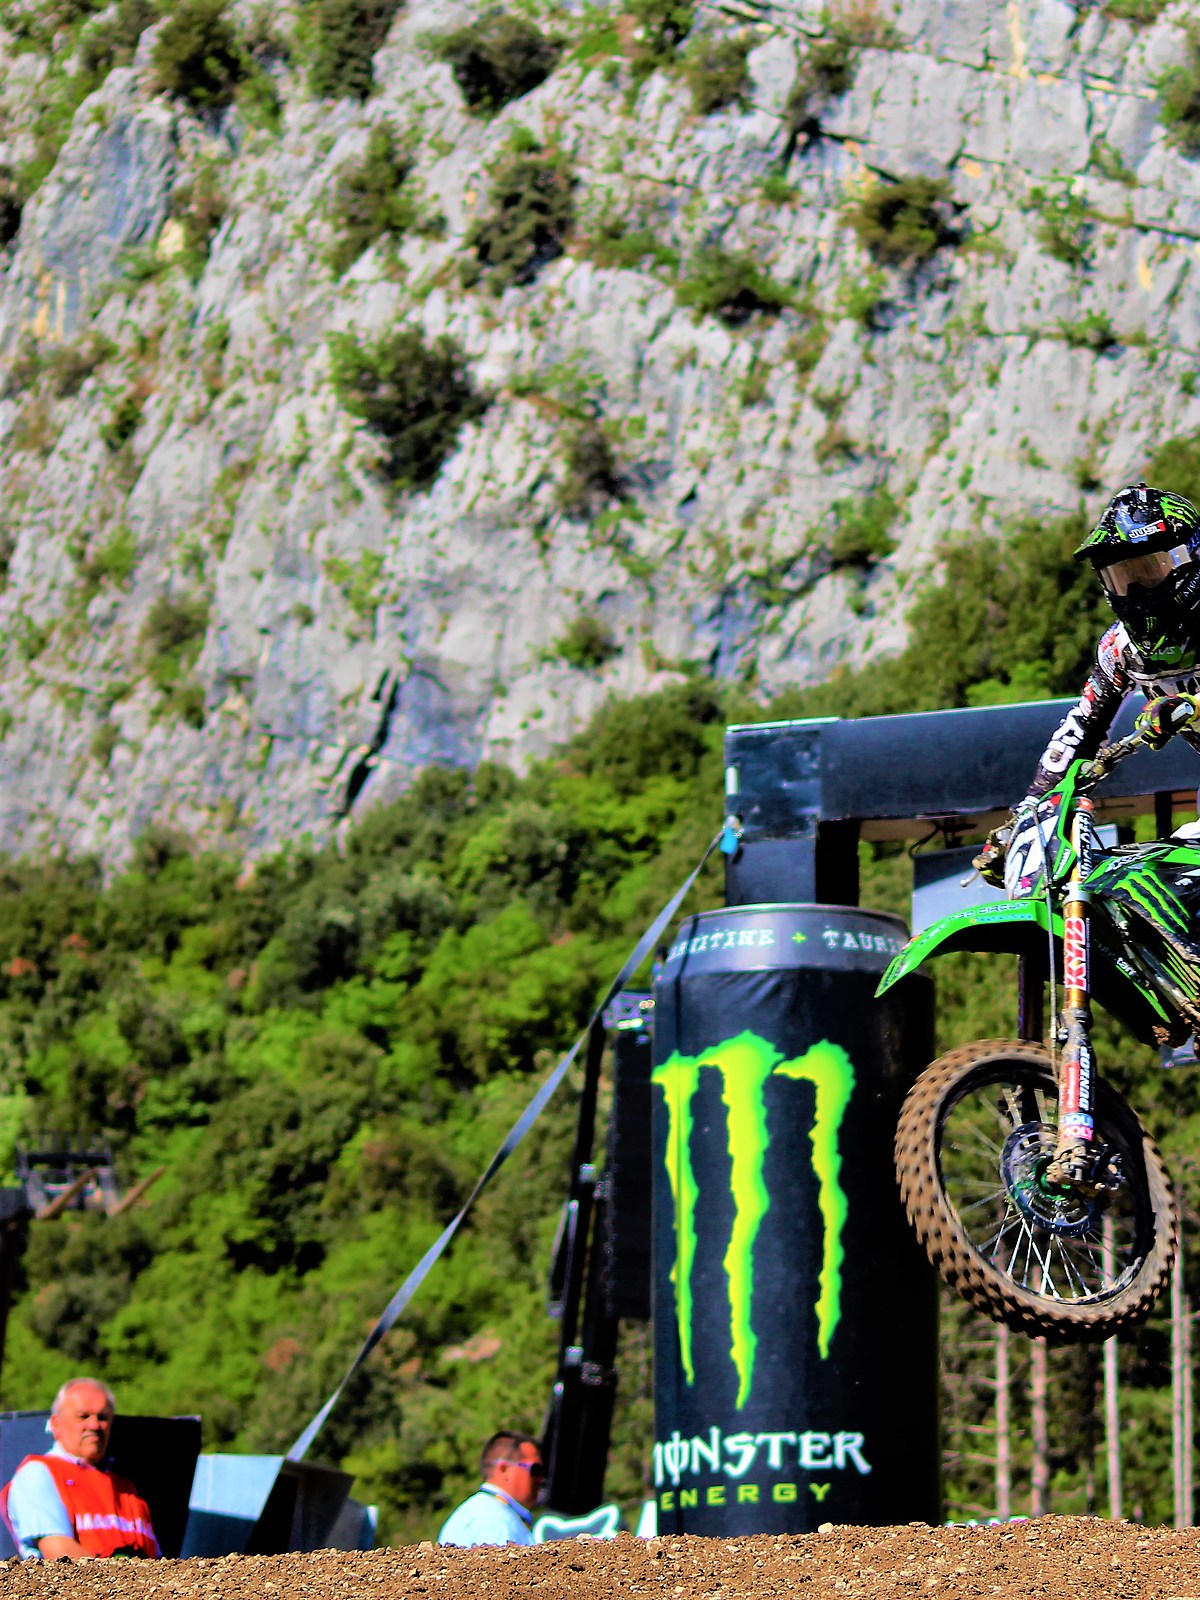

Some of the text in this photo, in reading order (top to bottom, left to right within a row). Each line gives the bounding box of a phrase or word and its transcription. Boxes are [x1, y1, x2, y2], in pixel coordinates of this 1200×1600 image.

[979, 902, 1029, 914] CIRCUIT
[1064, 917, 1087, 991] KYB
[1078, 1046, 1091, 1111] DUNLOP
[660, 1483, 831, 1512] ENERGY
